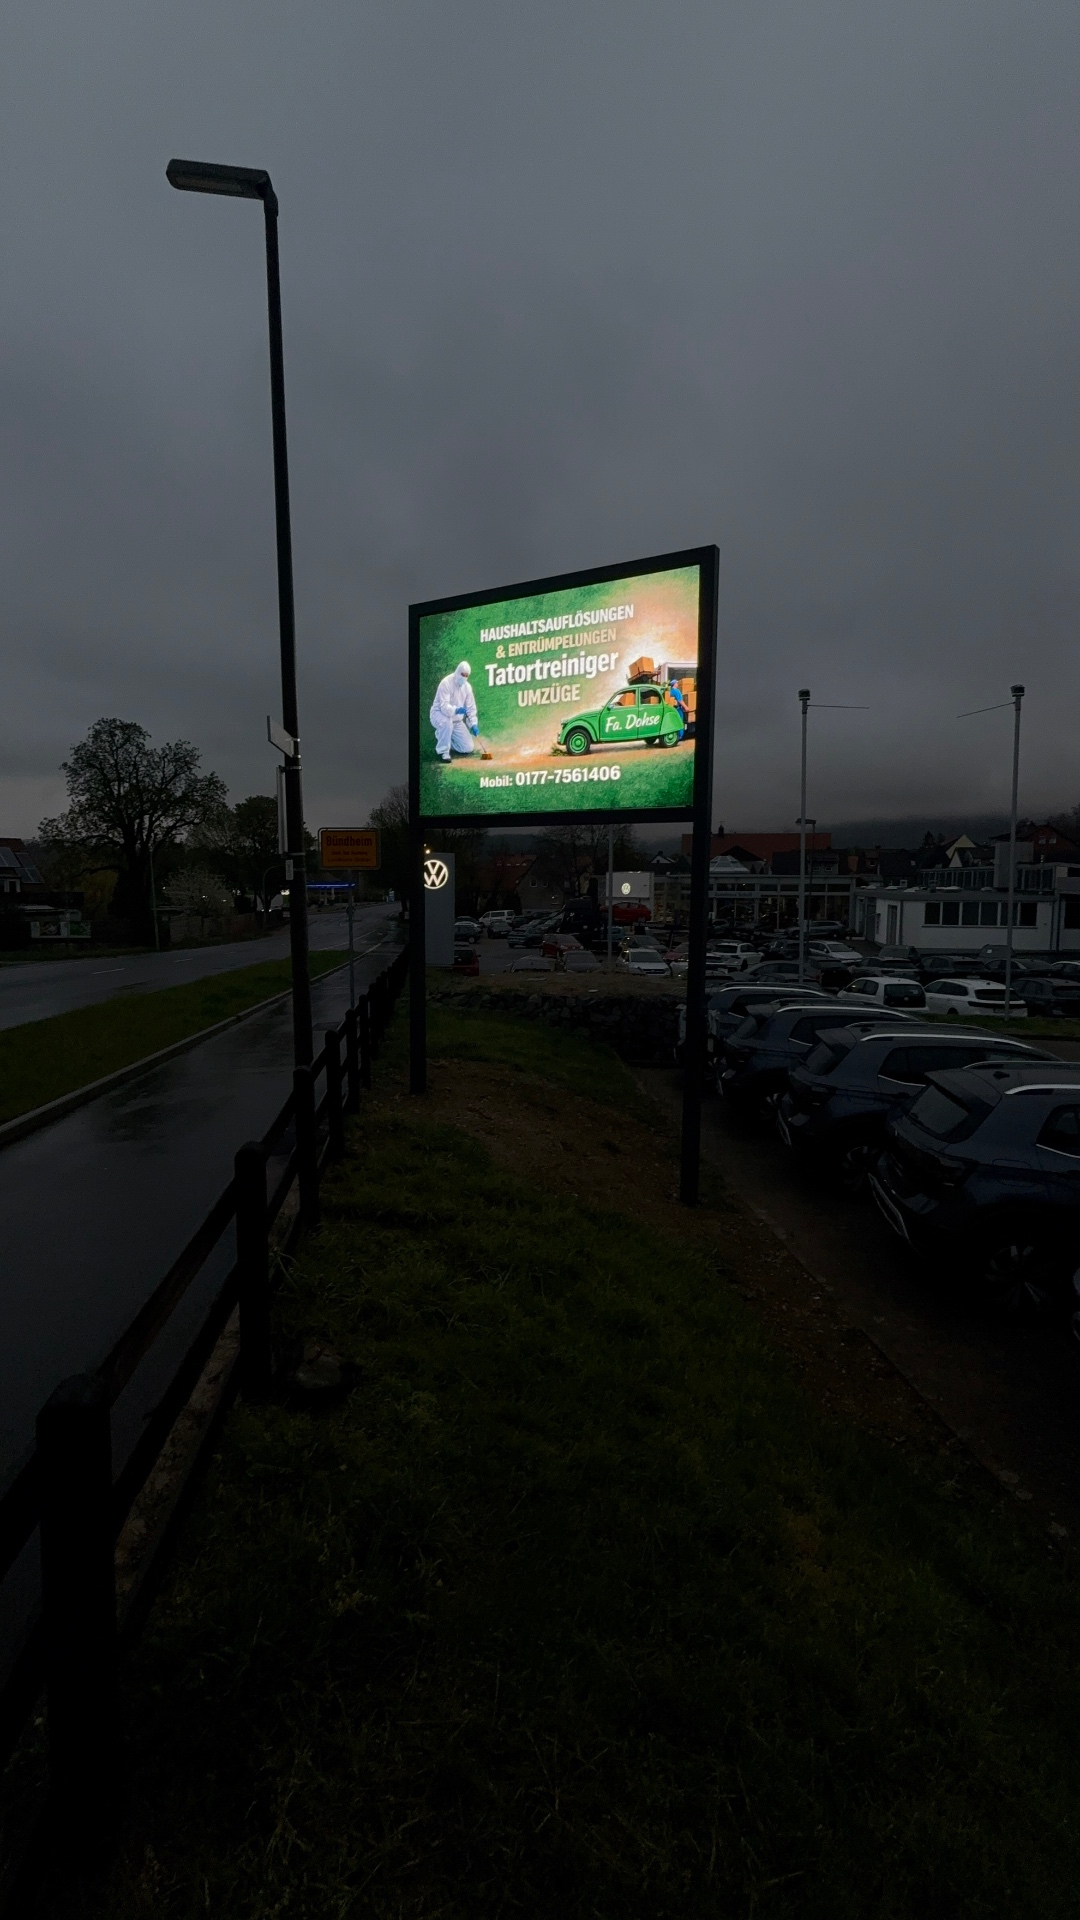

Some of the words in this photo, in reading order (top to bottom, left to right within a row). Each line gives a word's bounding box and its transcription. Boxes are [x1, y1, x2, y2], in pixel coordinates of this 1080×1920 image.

[480, 604, 634, 642] HAUSHALTSAUFLÖSUNGEN
[496, 645, 506, 659] &
[508, 628, 617, 657] ENTRÜMPELUNGEN
[485, 651, 619, 687] Tatortreiniger
[518, 684, 581, 708] UMZÜGE
[605, 716, 622, 733] Fa.
[625, 712, 660, 730] Dohse
[480, 775, 513, 788] Mobil:
[515, 766, 621, 785] 0177-7561406
[326, 835, 373, 847] Bündheim
